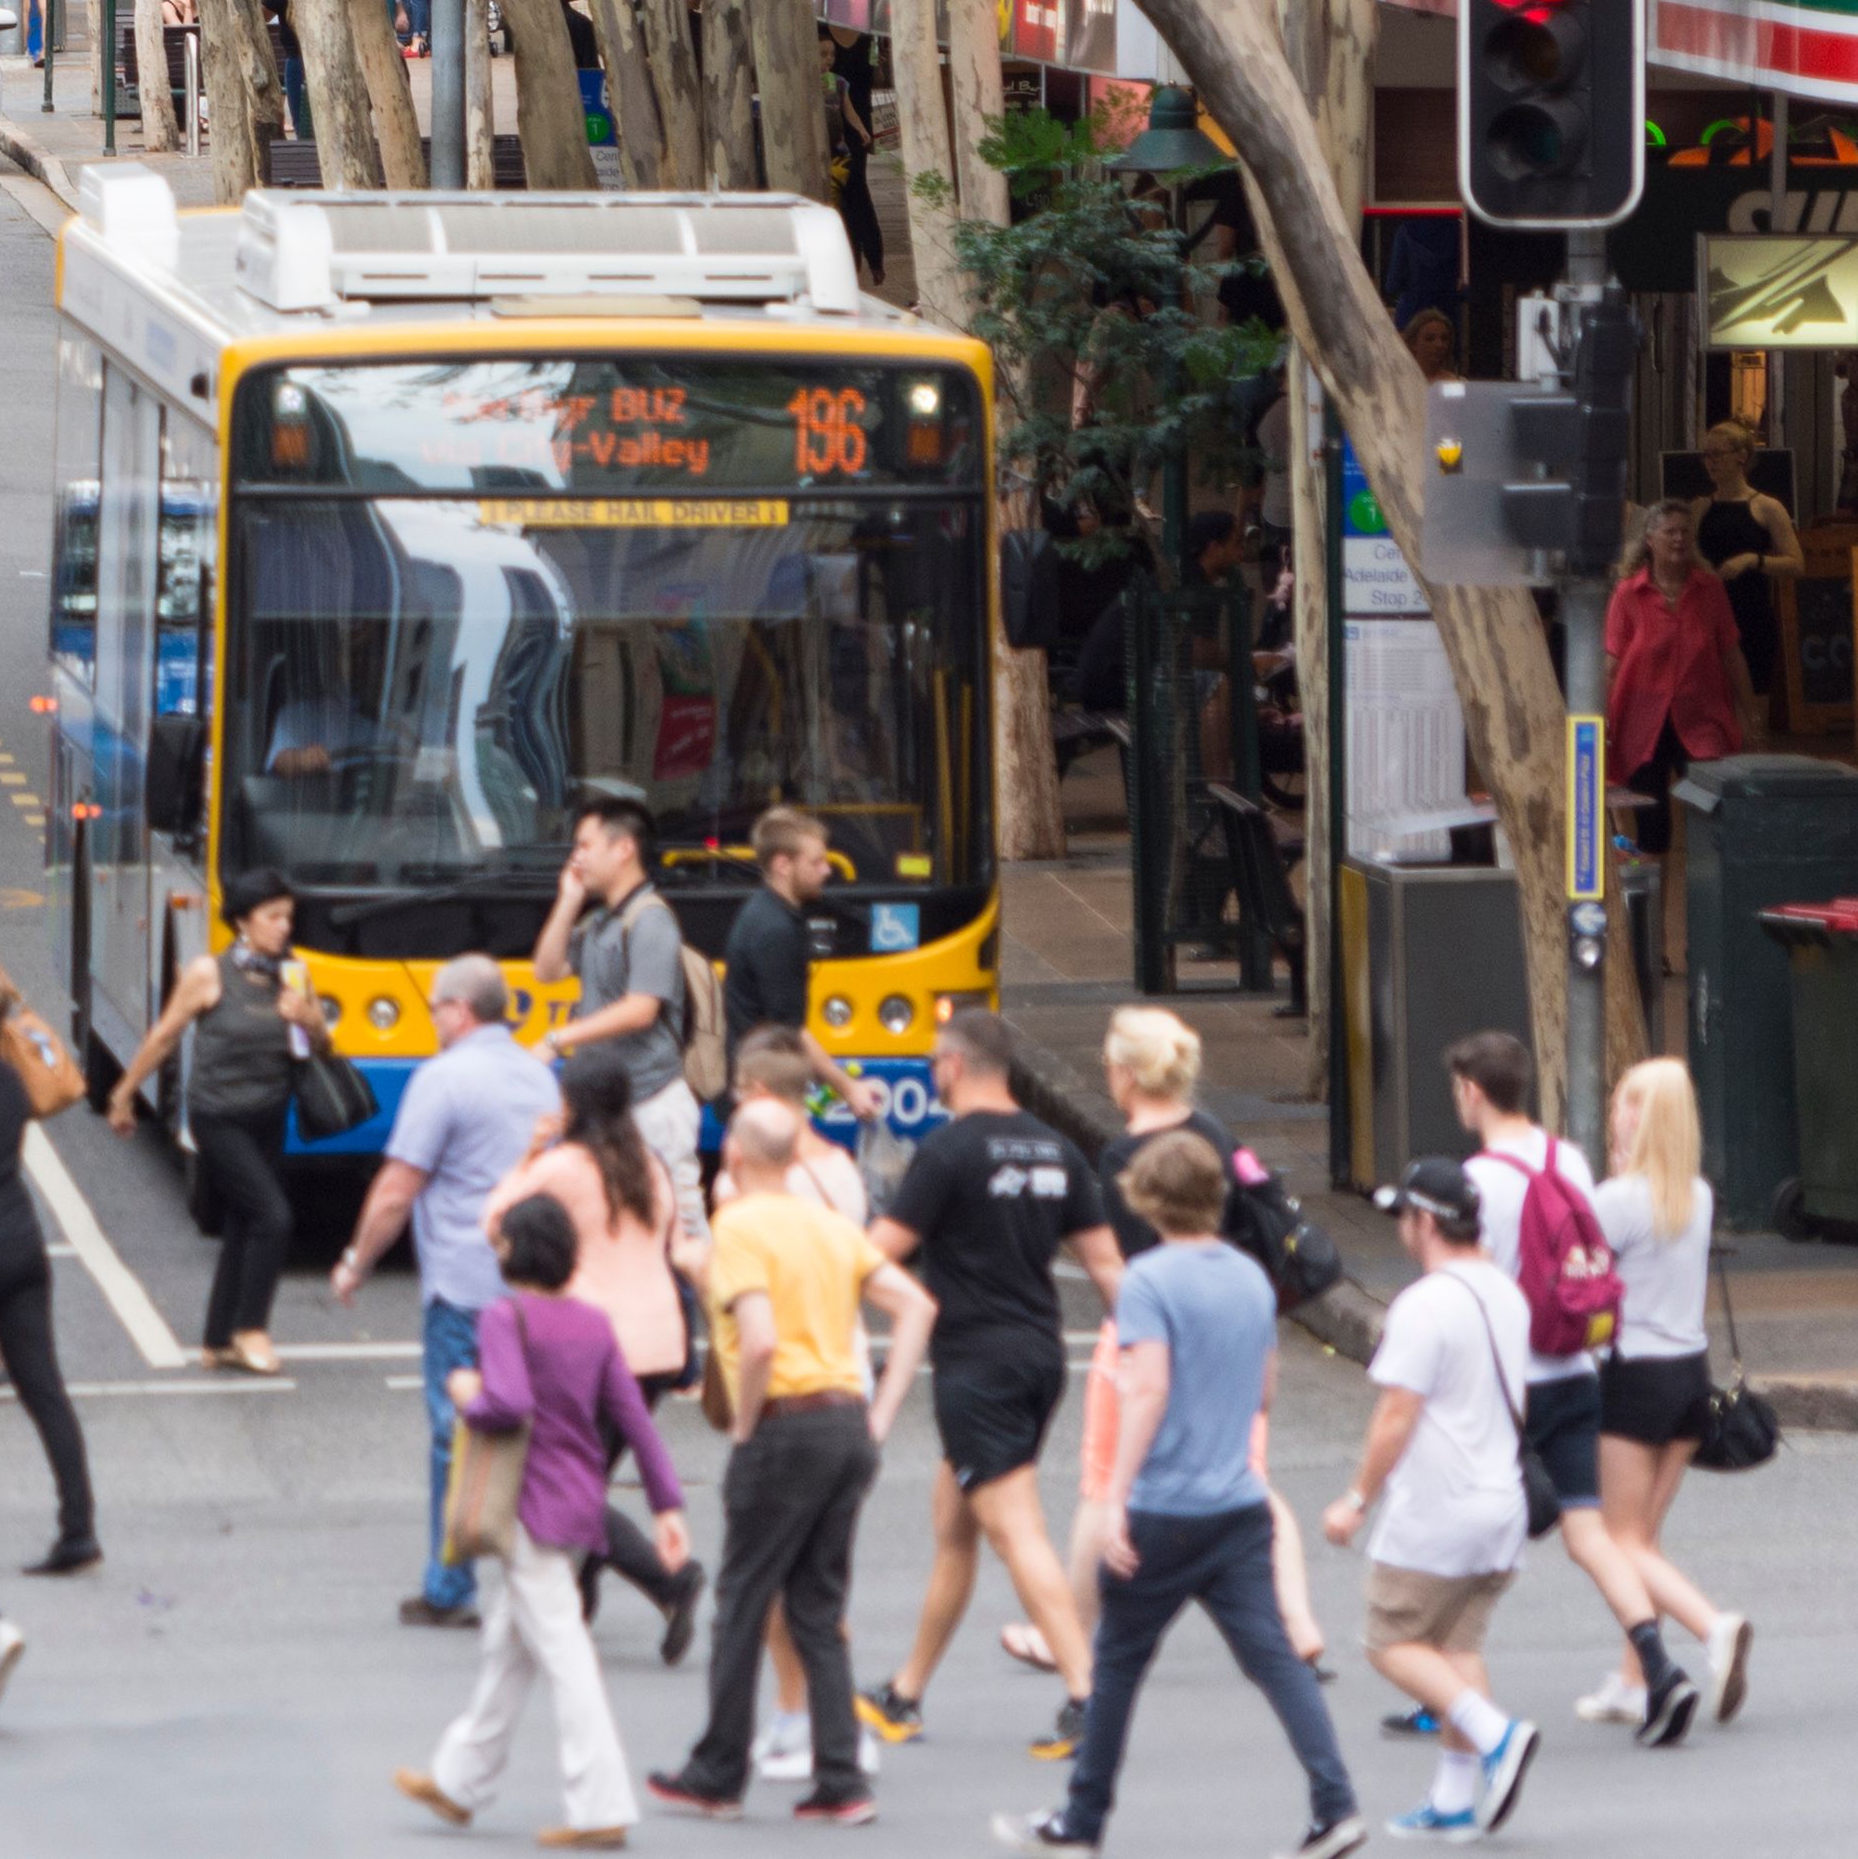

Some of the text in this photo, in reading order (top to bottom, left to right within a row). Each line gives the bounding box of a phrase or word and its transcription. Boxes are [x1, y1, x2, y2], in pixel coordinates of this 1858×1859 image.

[611, 387, 687, 423] BUZ
[787, 385, 867, 475] 196
[503, 502, 757, 521] PLEASE HAIL DRIVER
[1344, 567, 1408, 583] Adelaide
[1371, 589, 1407, 609] Stop
